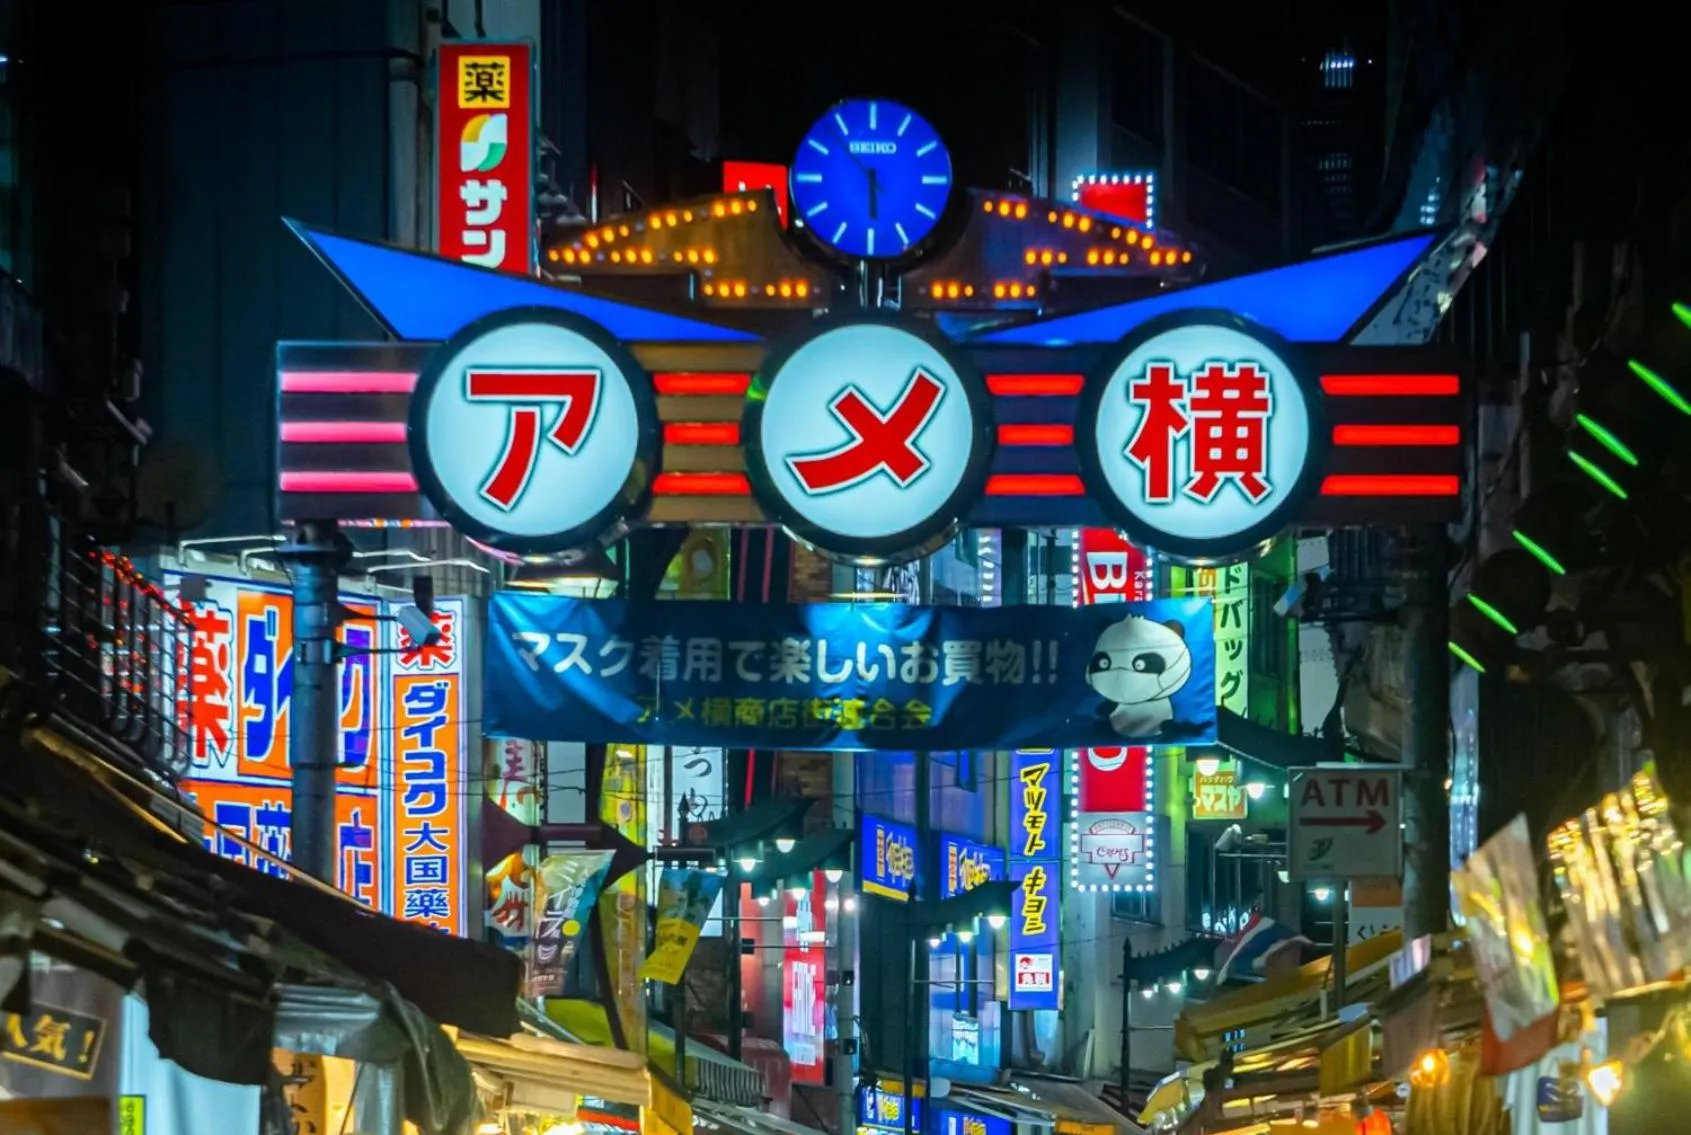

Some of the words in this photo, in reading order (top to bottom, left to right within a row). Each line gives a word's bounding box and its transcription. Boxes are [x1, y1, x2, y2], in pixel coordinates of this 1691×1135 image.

[464, 61, 505, 103] 薬
[466, 361, 1271, 510] アメ横
[1300, 777, 1390, 808] ATM
